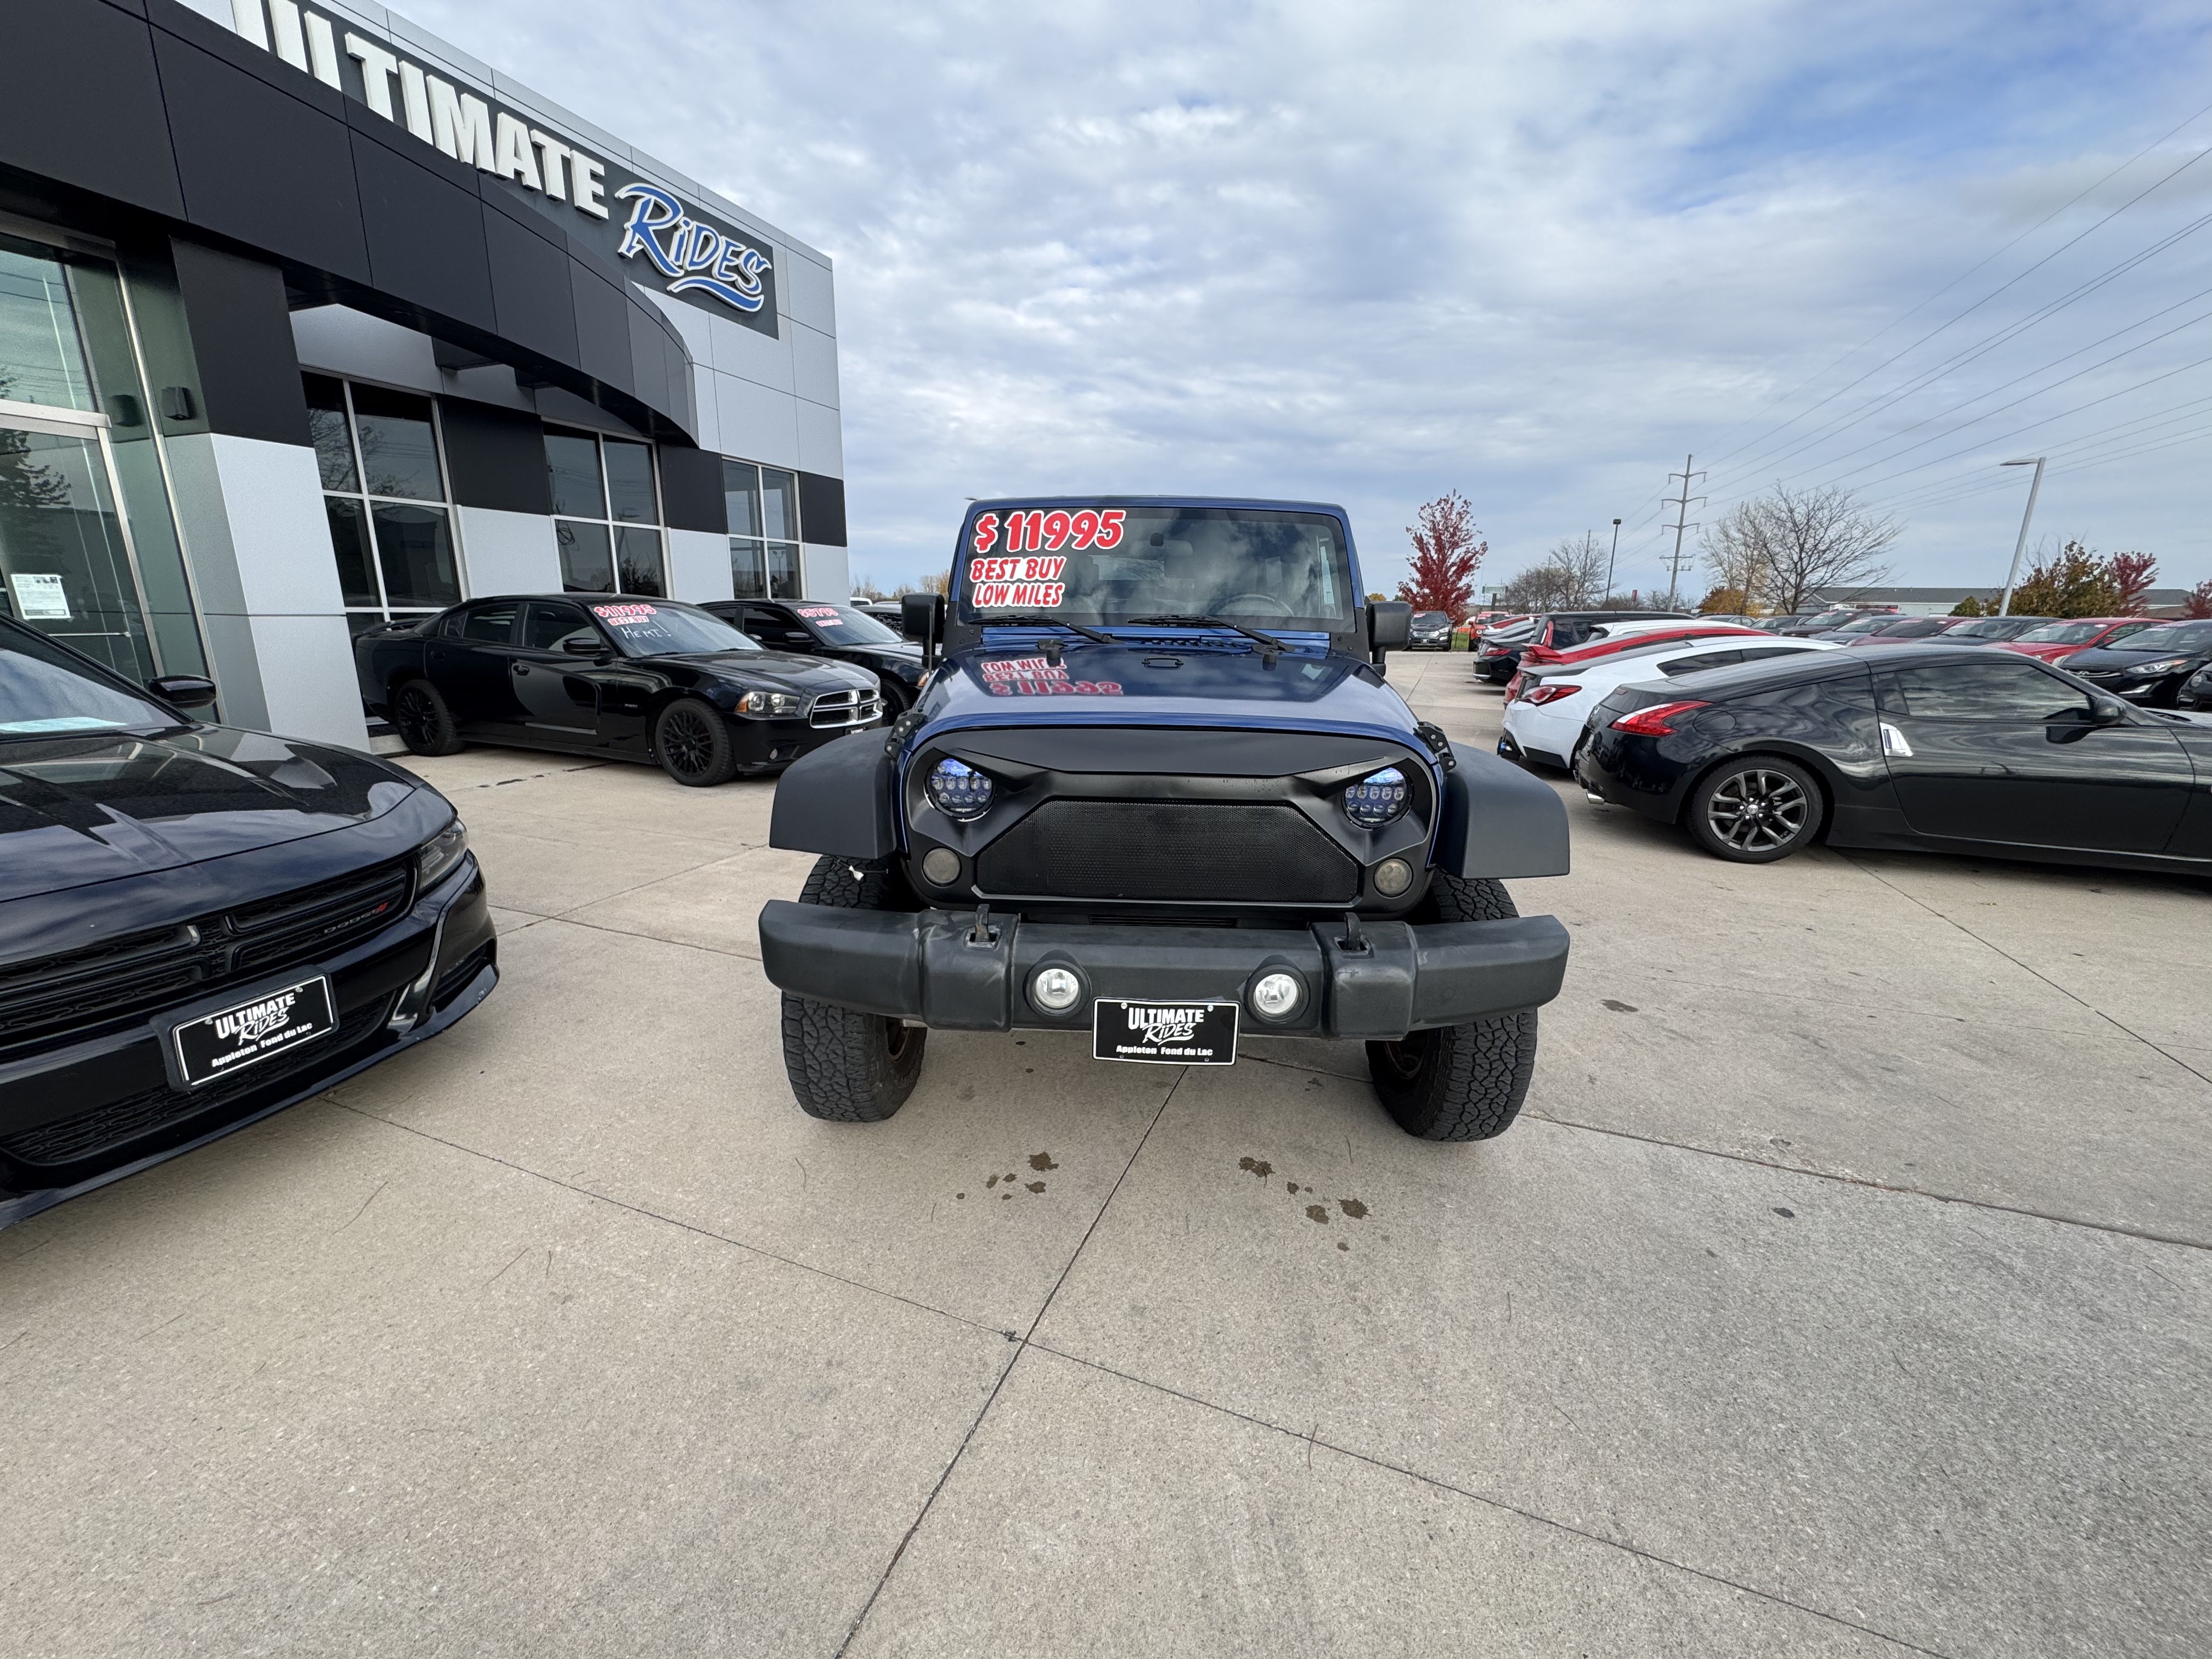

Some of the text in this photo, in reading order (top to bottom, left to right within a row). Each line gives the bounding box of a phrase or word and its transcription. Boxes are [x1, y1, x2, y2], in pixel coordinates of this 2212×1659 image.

[970, 556, 1066, 581] BEST BUY
[972, 582, 1065, 607] LOW MILES
[215, 992, 296, 1039] ULTIMATE
[1127, 1007, 1205, 1030] ULTIMATE
[211, 1022, 313, 1068] Appleton Fond du Lac
[1116, 1045, 1214, 1056] Appleton Fond du Lac
